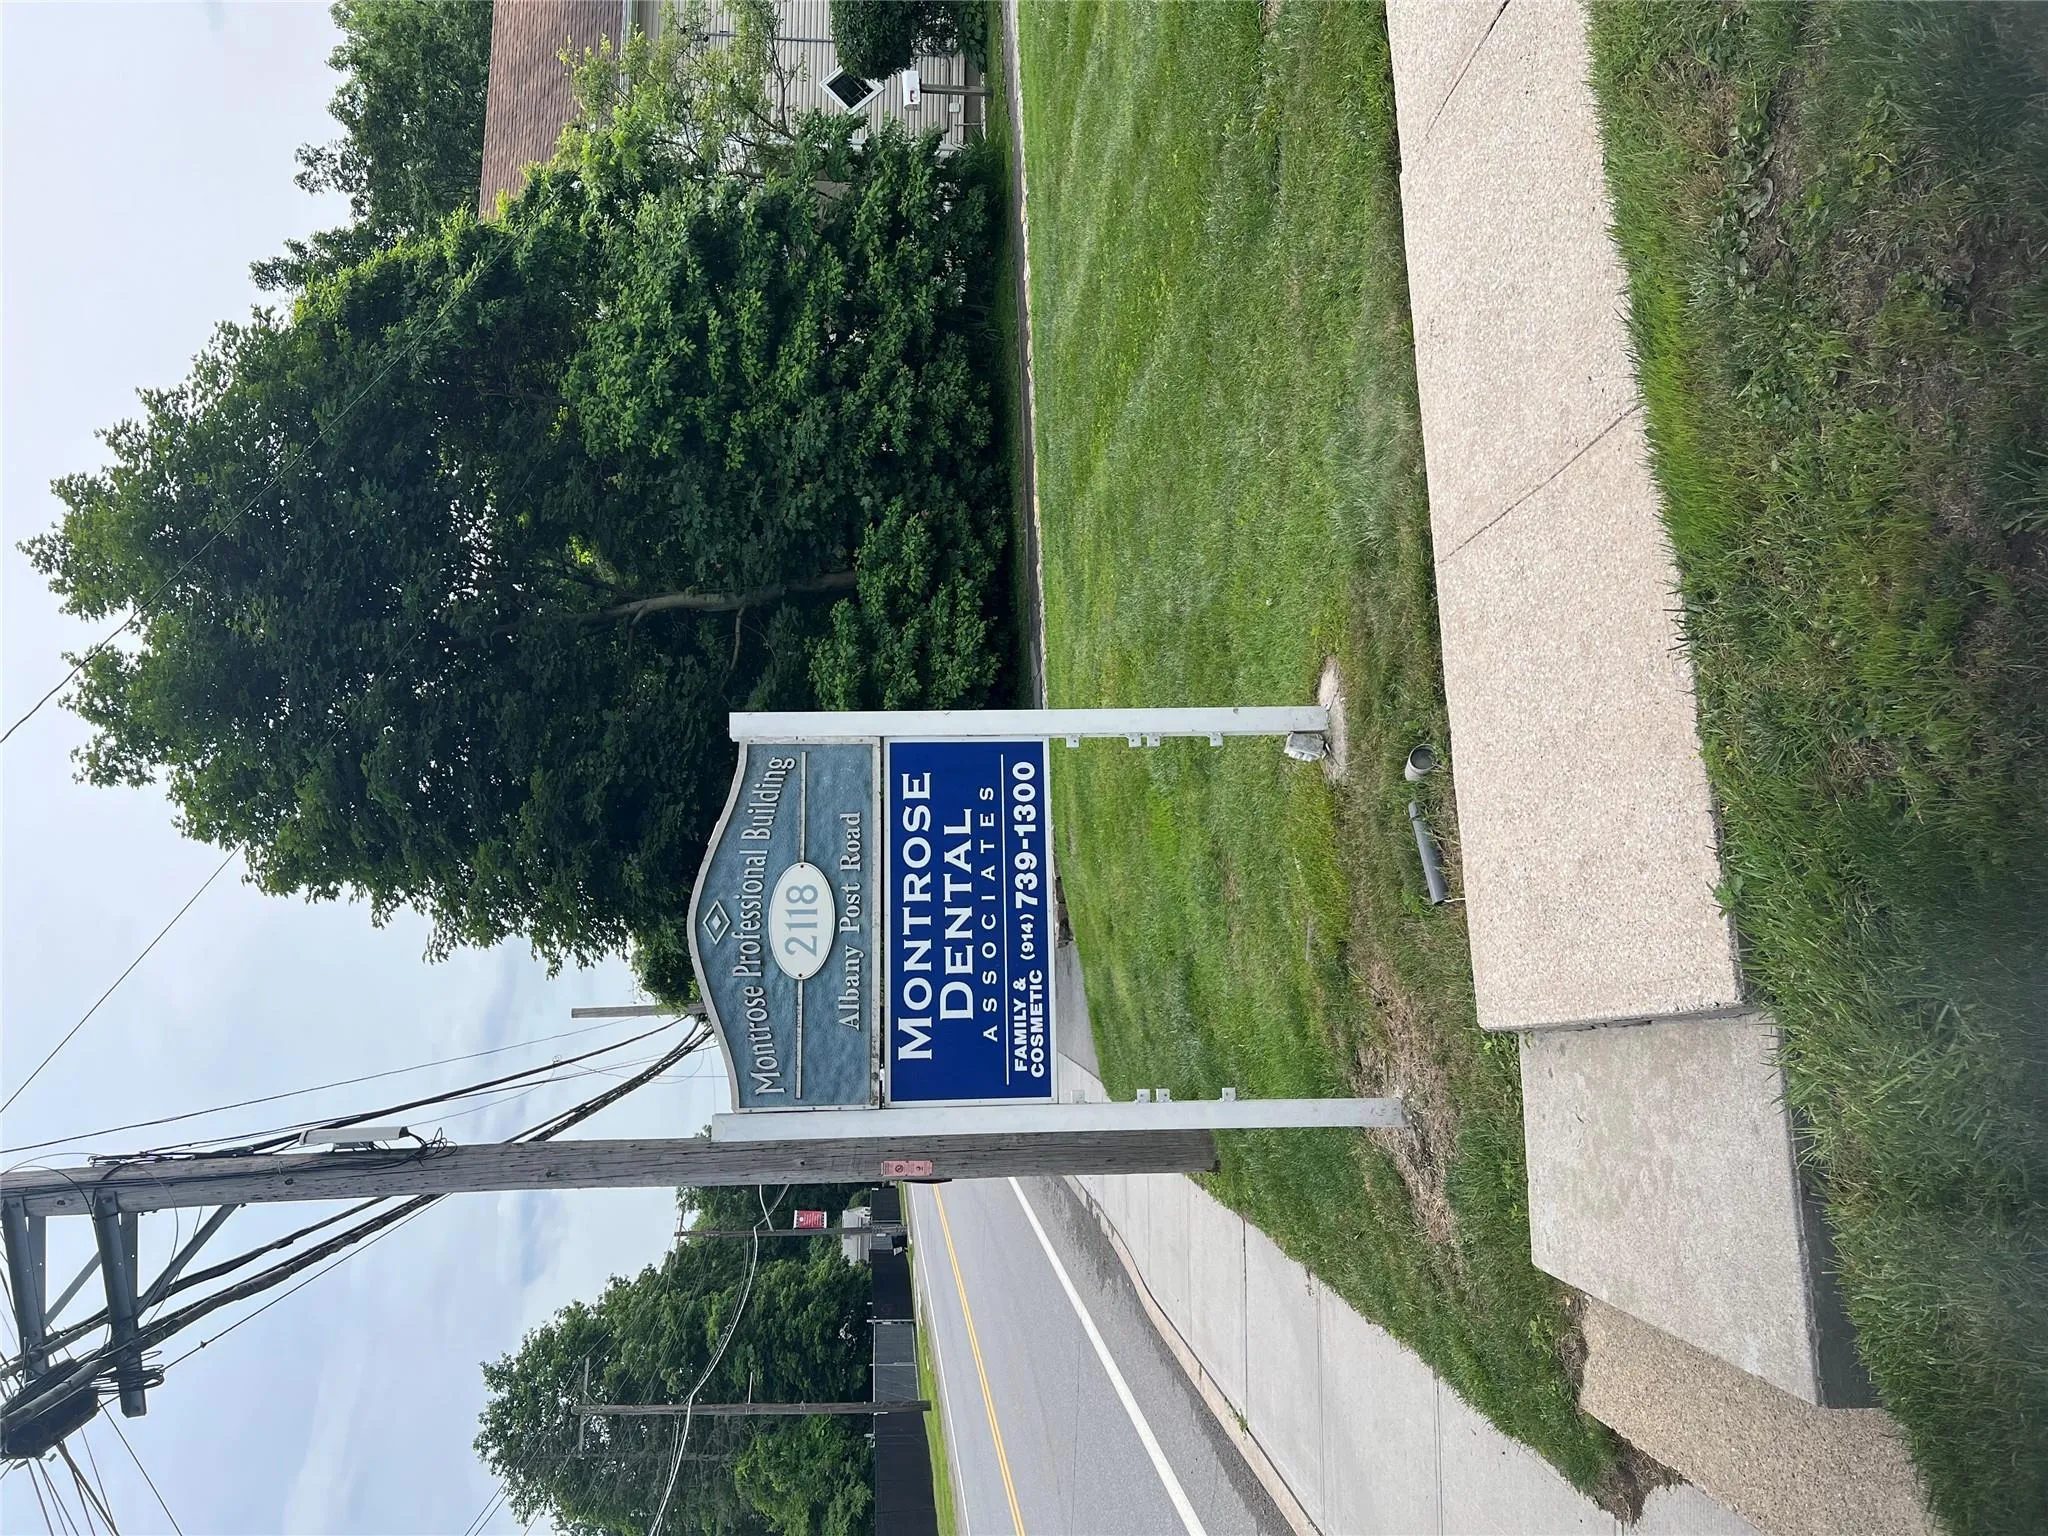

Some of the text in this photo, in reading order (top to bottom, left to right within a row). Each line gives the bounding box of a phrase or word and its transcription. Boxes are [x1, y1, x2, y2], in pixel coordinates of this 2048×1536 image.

[732, 757, 796, 1097] Montrose Professional Building
[784, 883, 819, 957] 2118
[839, 811, 865, 1031] Albany Post Road
[898, 771, 933, 1061] MONTROSE
[939, 808, 974, 1021] DENTAL
[1012, 761, 1038, 960] (914) 739-1300
[1013, 977, 1028, 1072] FAMILY &
[1030, 969, 1044, 1078] COSMETIC
